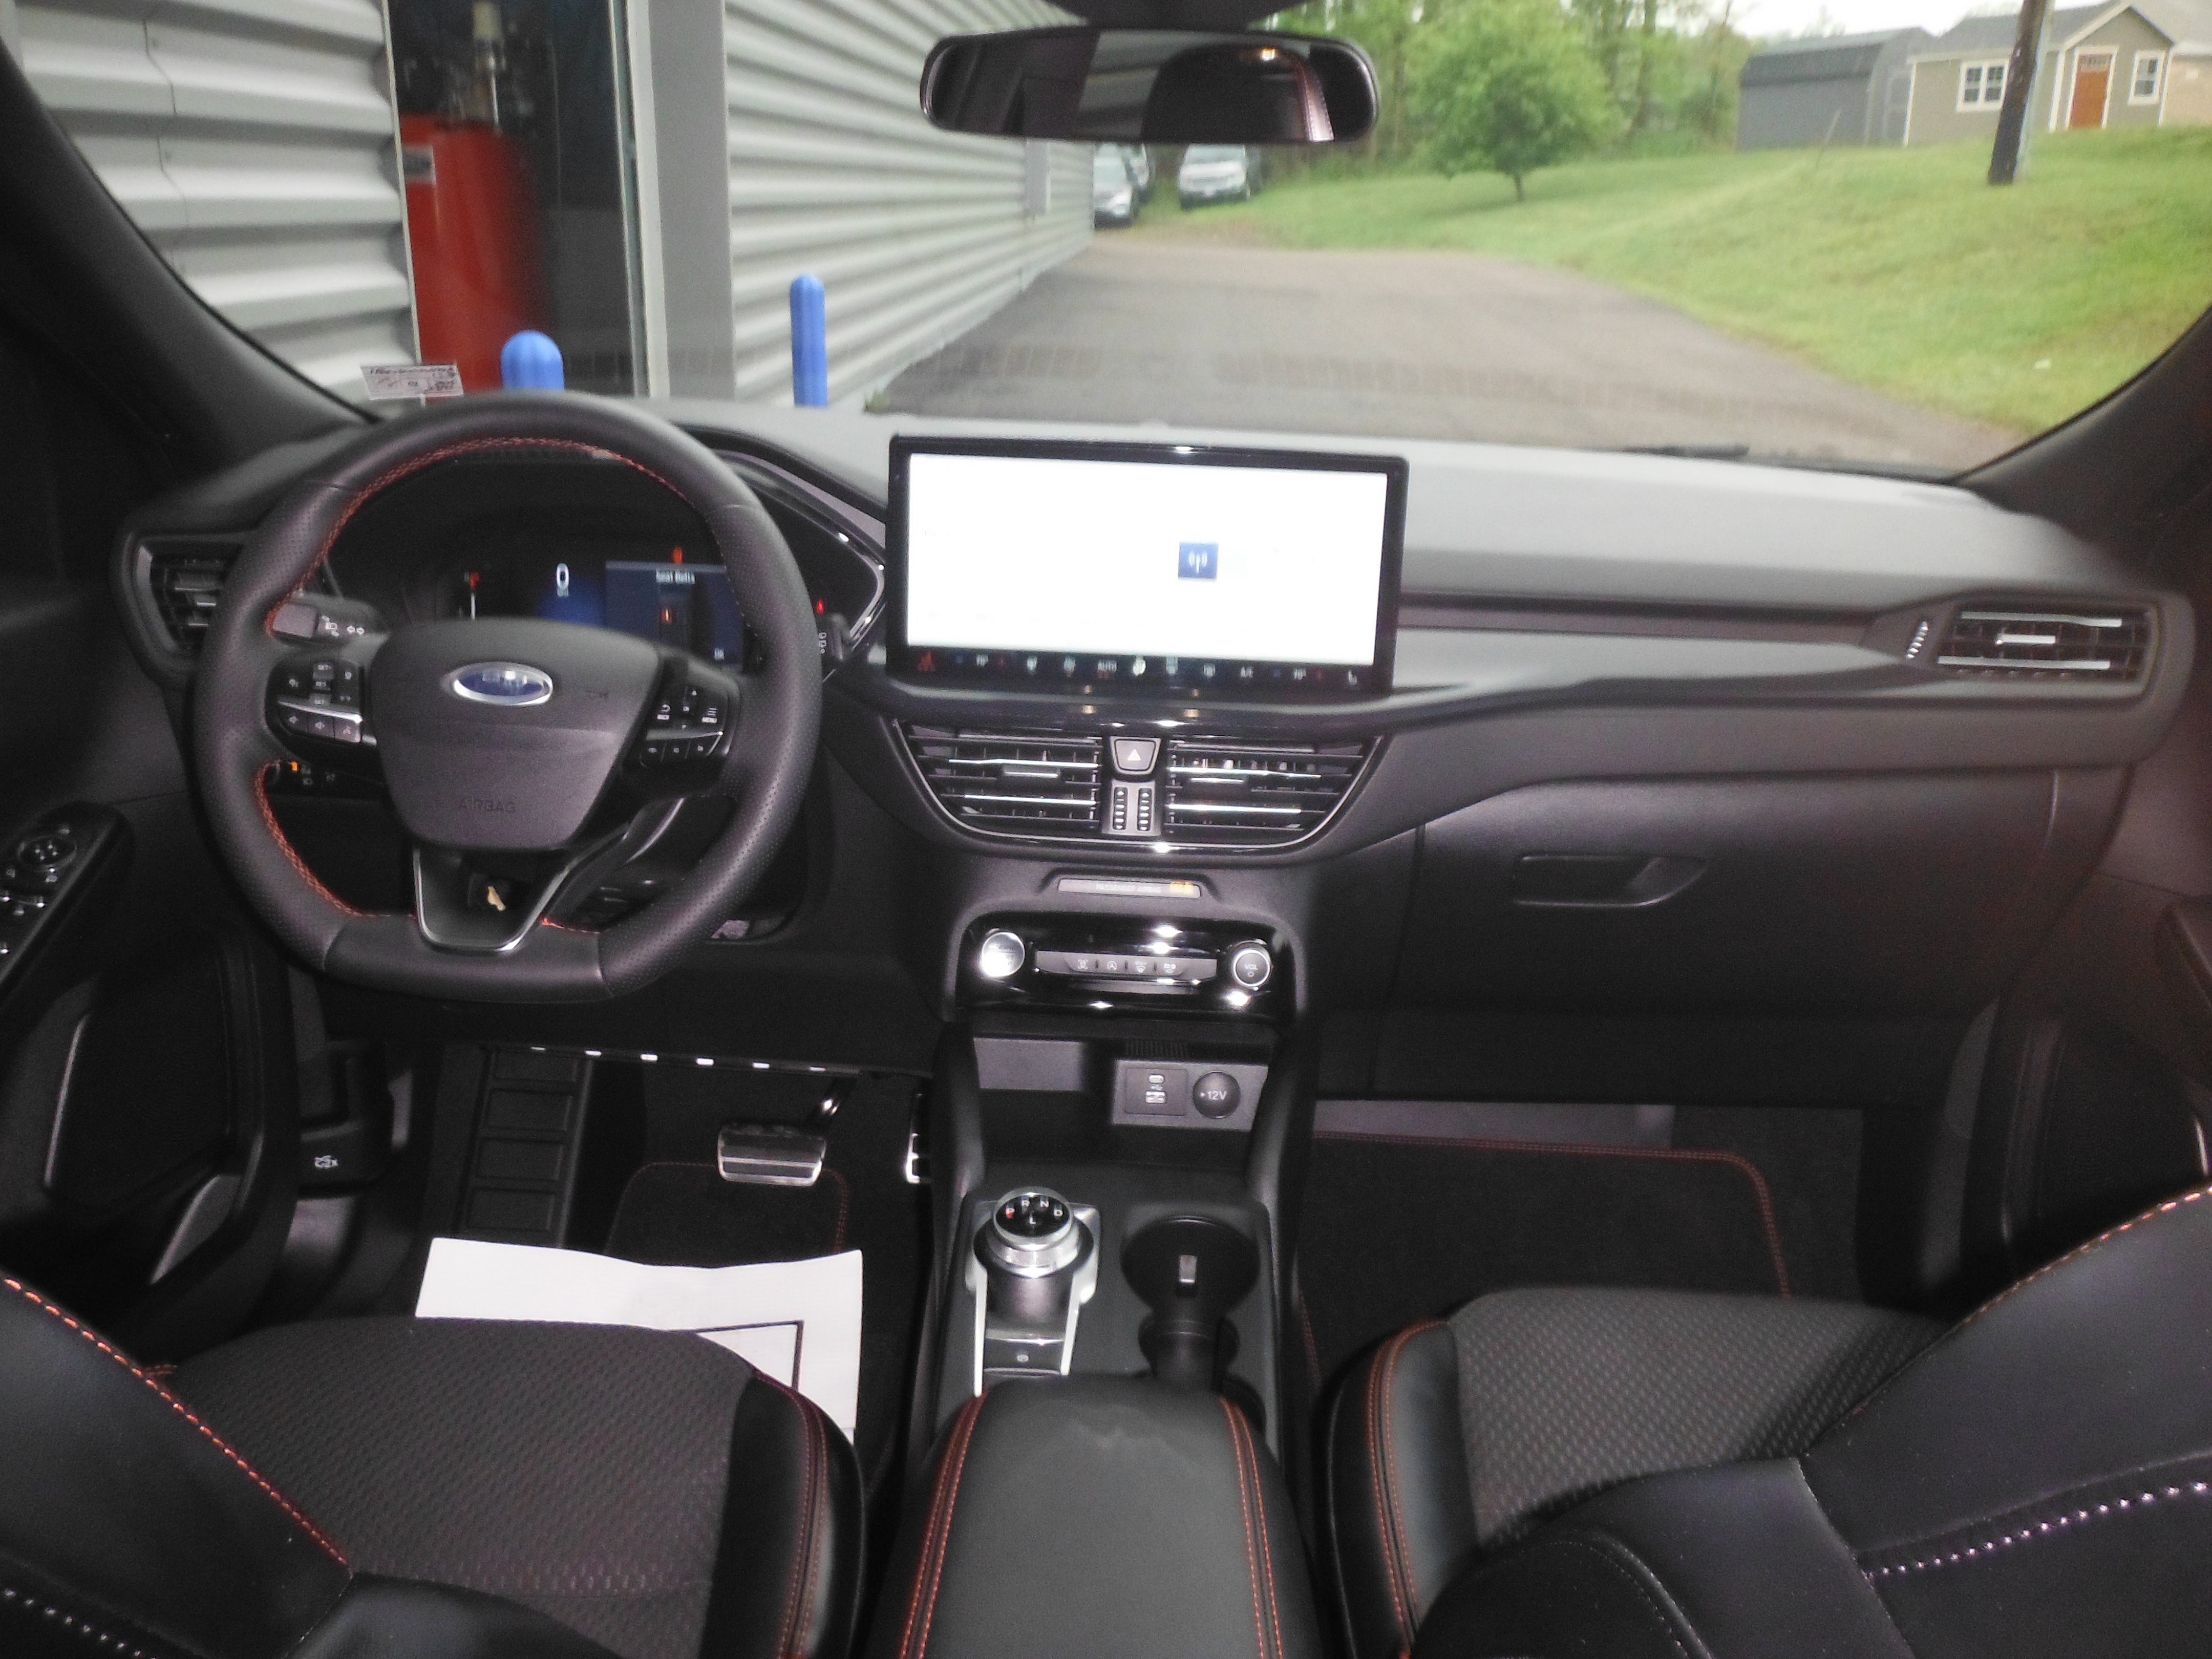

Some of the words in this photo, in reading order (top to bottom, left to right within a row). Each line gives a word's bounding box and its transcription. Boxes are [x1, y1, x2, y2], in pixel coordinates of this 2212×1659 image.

[556, 563, 569, 589] 0
[1207, 1090, 1227, 1100] 12V
[1021, 1200, 1030, 1208] R
[1029, 1215, 1036, 1225] L
